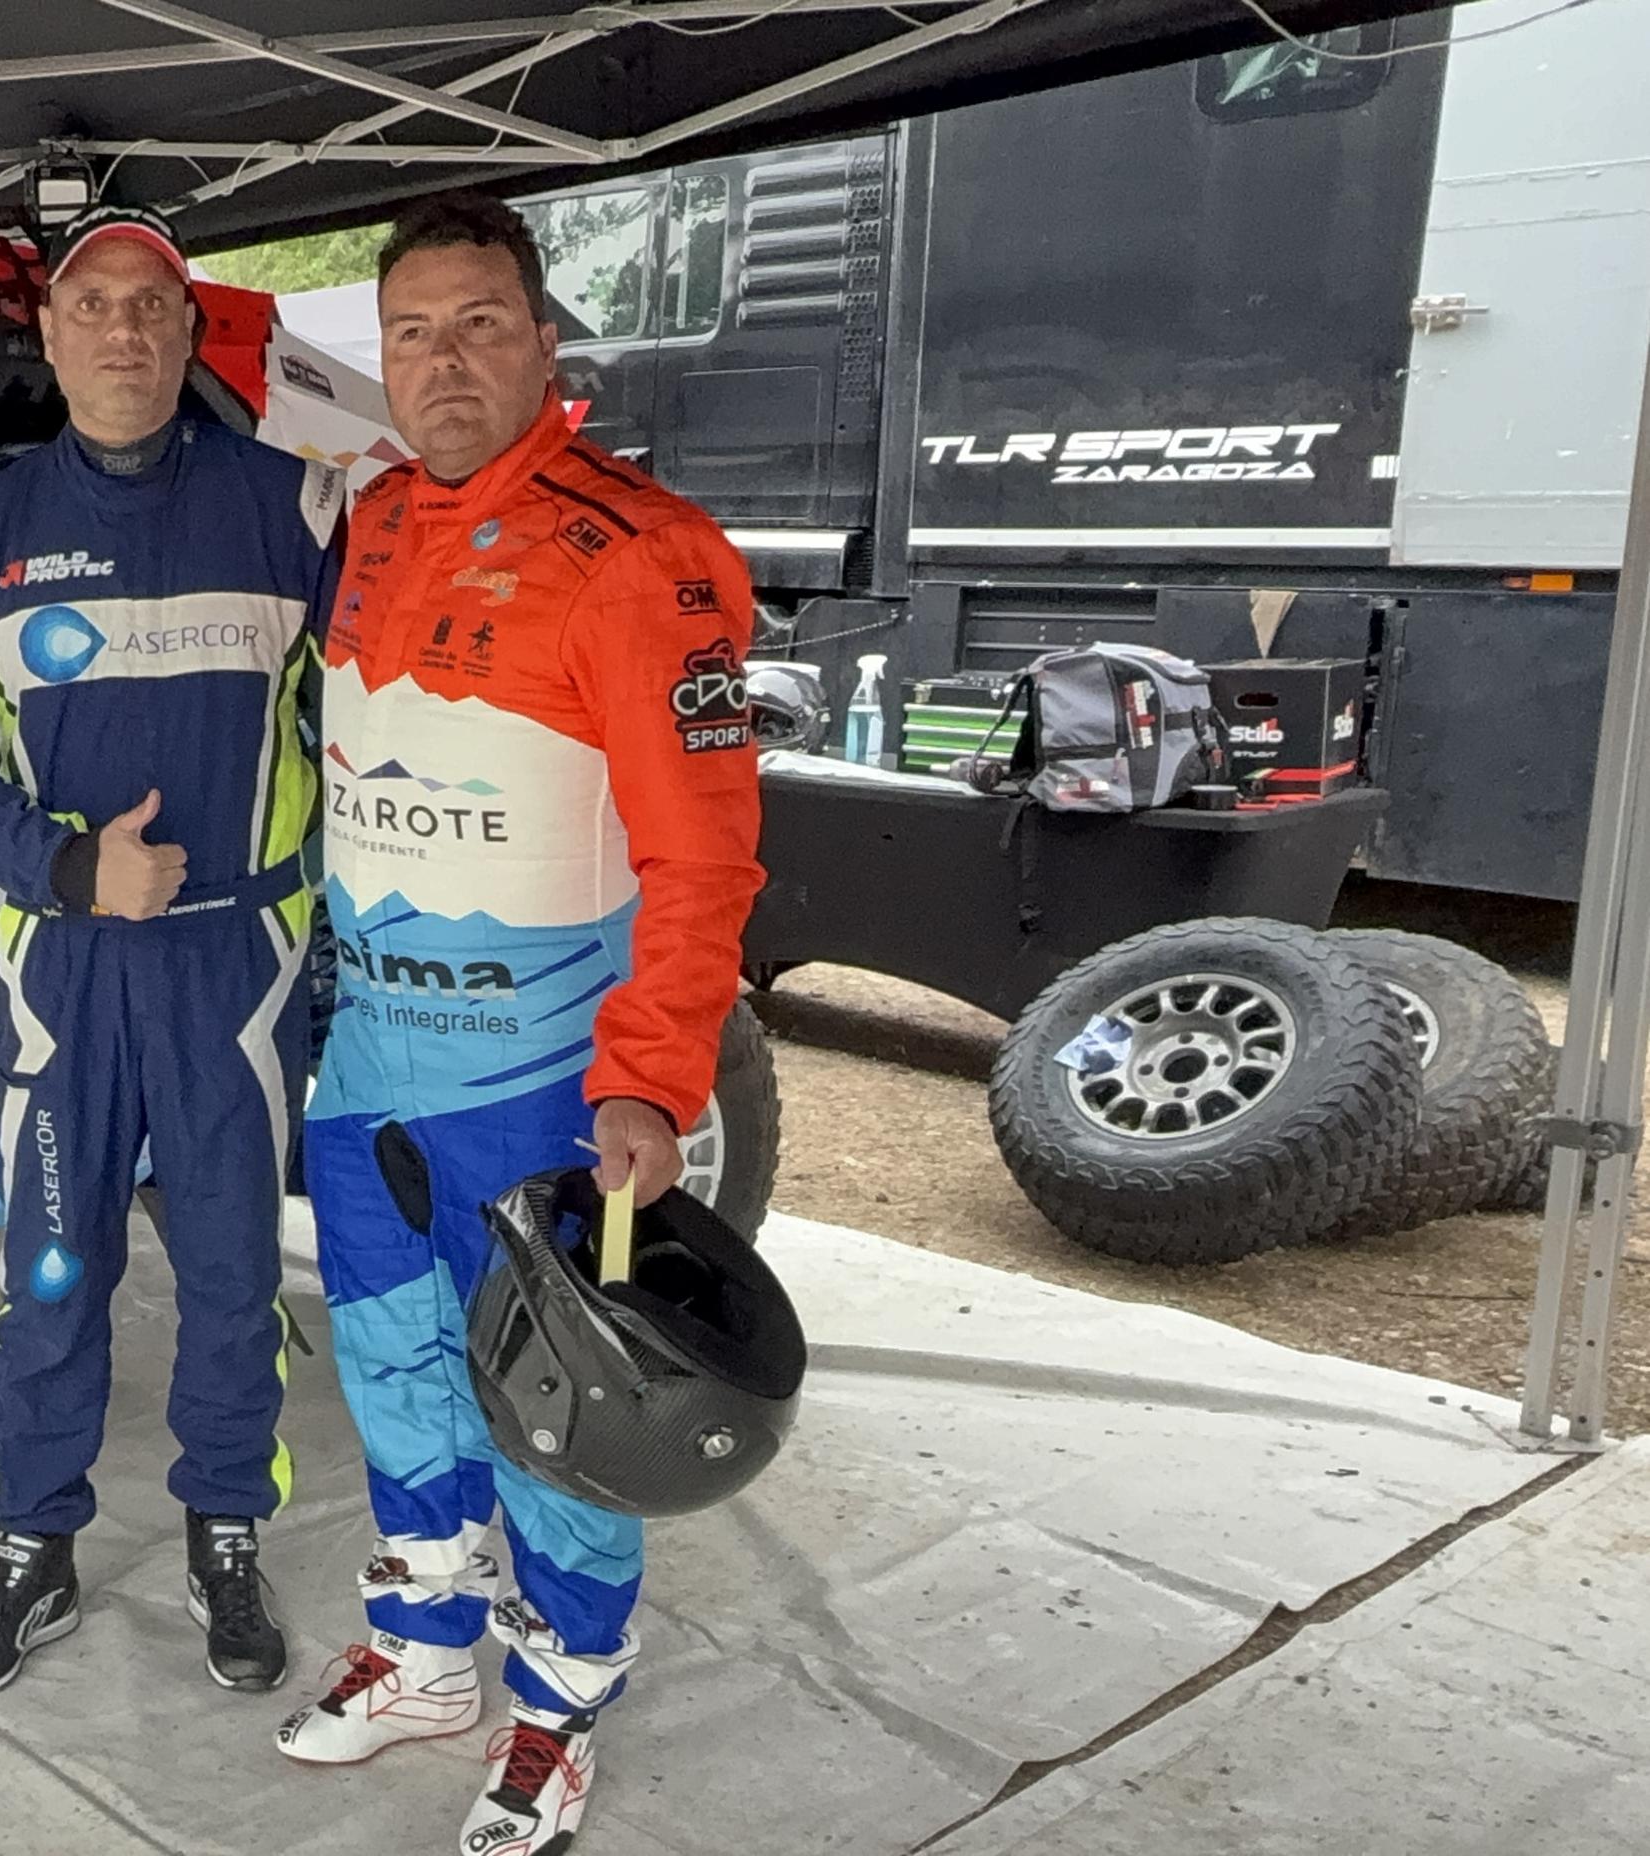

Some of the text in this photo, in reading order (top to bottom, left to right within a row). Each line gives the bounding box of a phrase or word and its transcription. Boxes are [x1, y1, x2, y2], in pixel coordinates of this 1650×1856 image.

[921, 422, 1341, 465] TLR SPORT
[1051, 460, 1316, 484] ZARAGOZA
[564, 519, 608, 552] OMP
[23, 561, 116, 586] PROTEC
[25, 551, 89, 571] WILD
[108, 623, 259, 654] LASERCOR
[686, 726, 749, 749] SPORT
[1229, 721, 1284, 742] Stilo
[386, 1003, 519, 1035] Integrales
[35, 1108, 64, 1235] LASERCOR
[378, 1633, 408, 1652] OMP
[469, 1821, 519, 1852] OMP
